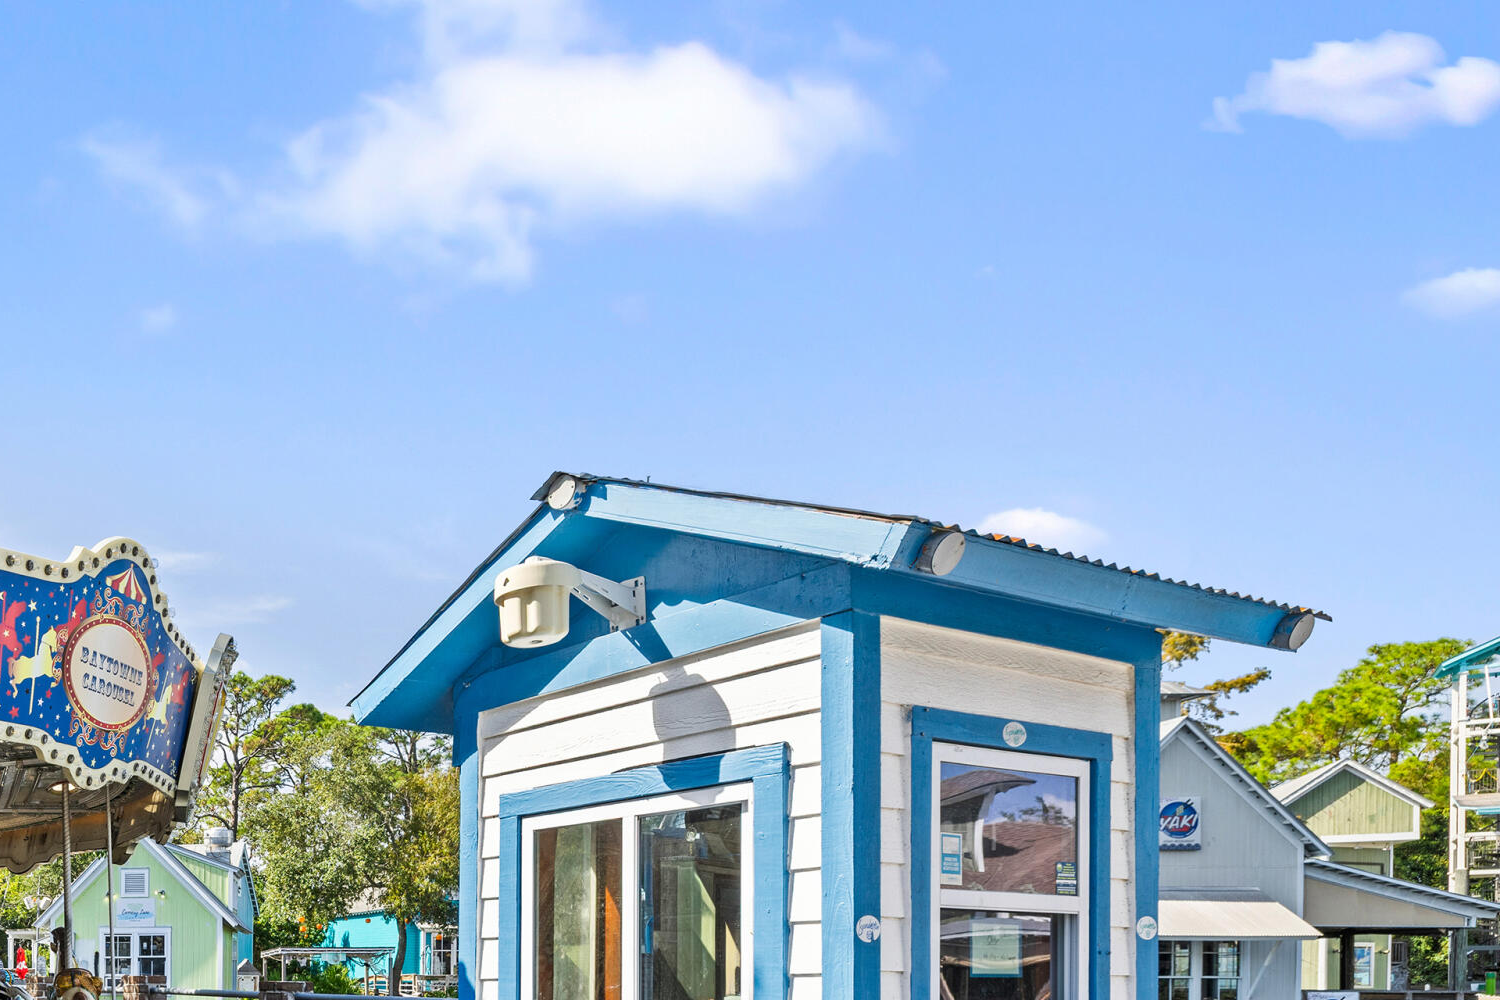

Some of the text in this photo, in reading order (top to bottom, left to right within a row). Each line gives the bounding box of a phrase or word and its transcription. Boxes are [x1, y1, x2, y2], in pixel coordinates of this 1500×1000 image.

[80, 646, 143, 687] BAYTOWNE
[81, 672, 137, 707] CAROUSEL
[1160, 814, 1198, 830] YAKI
